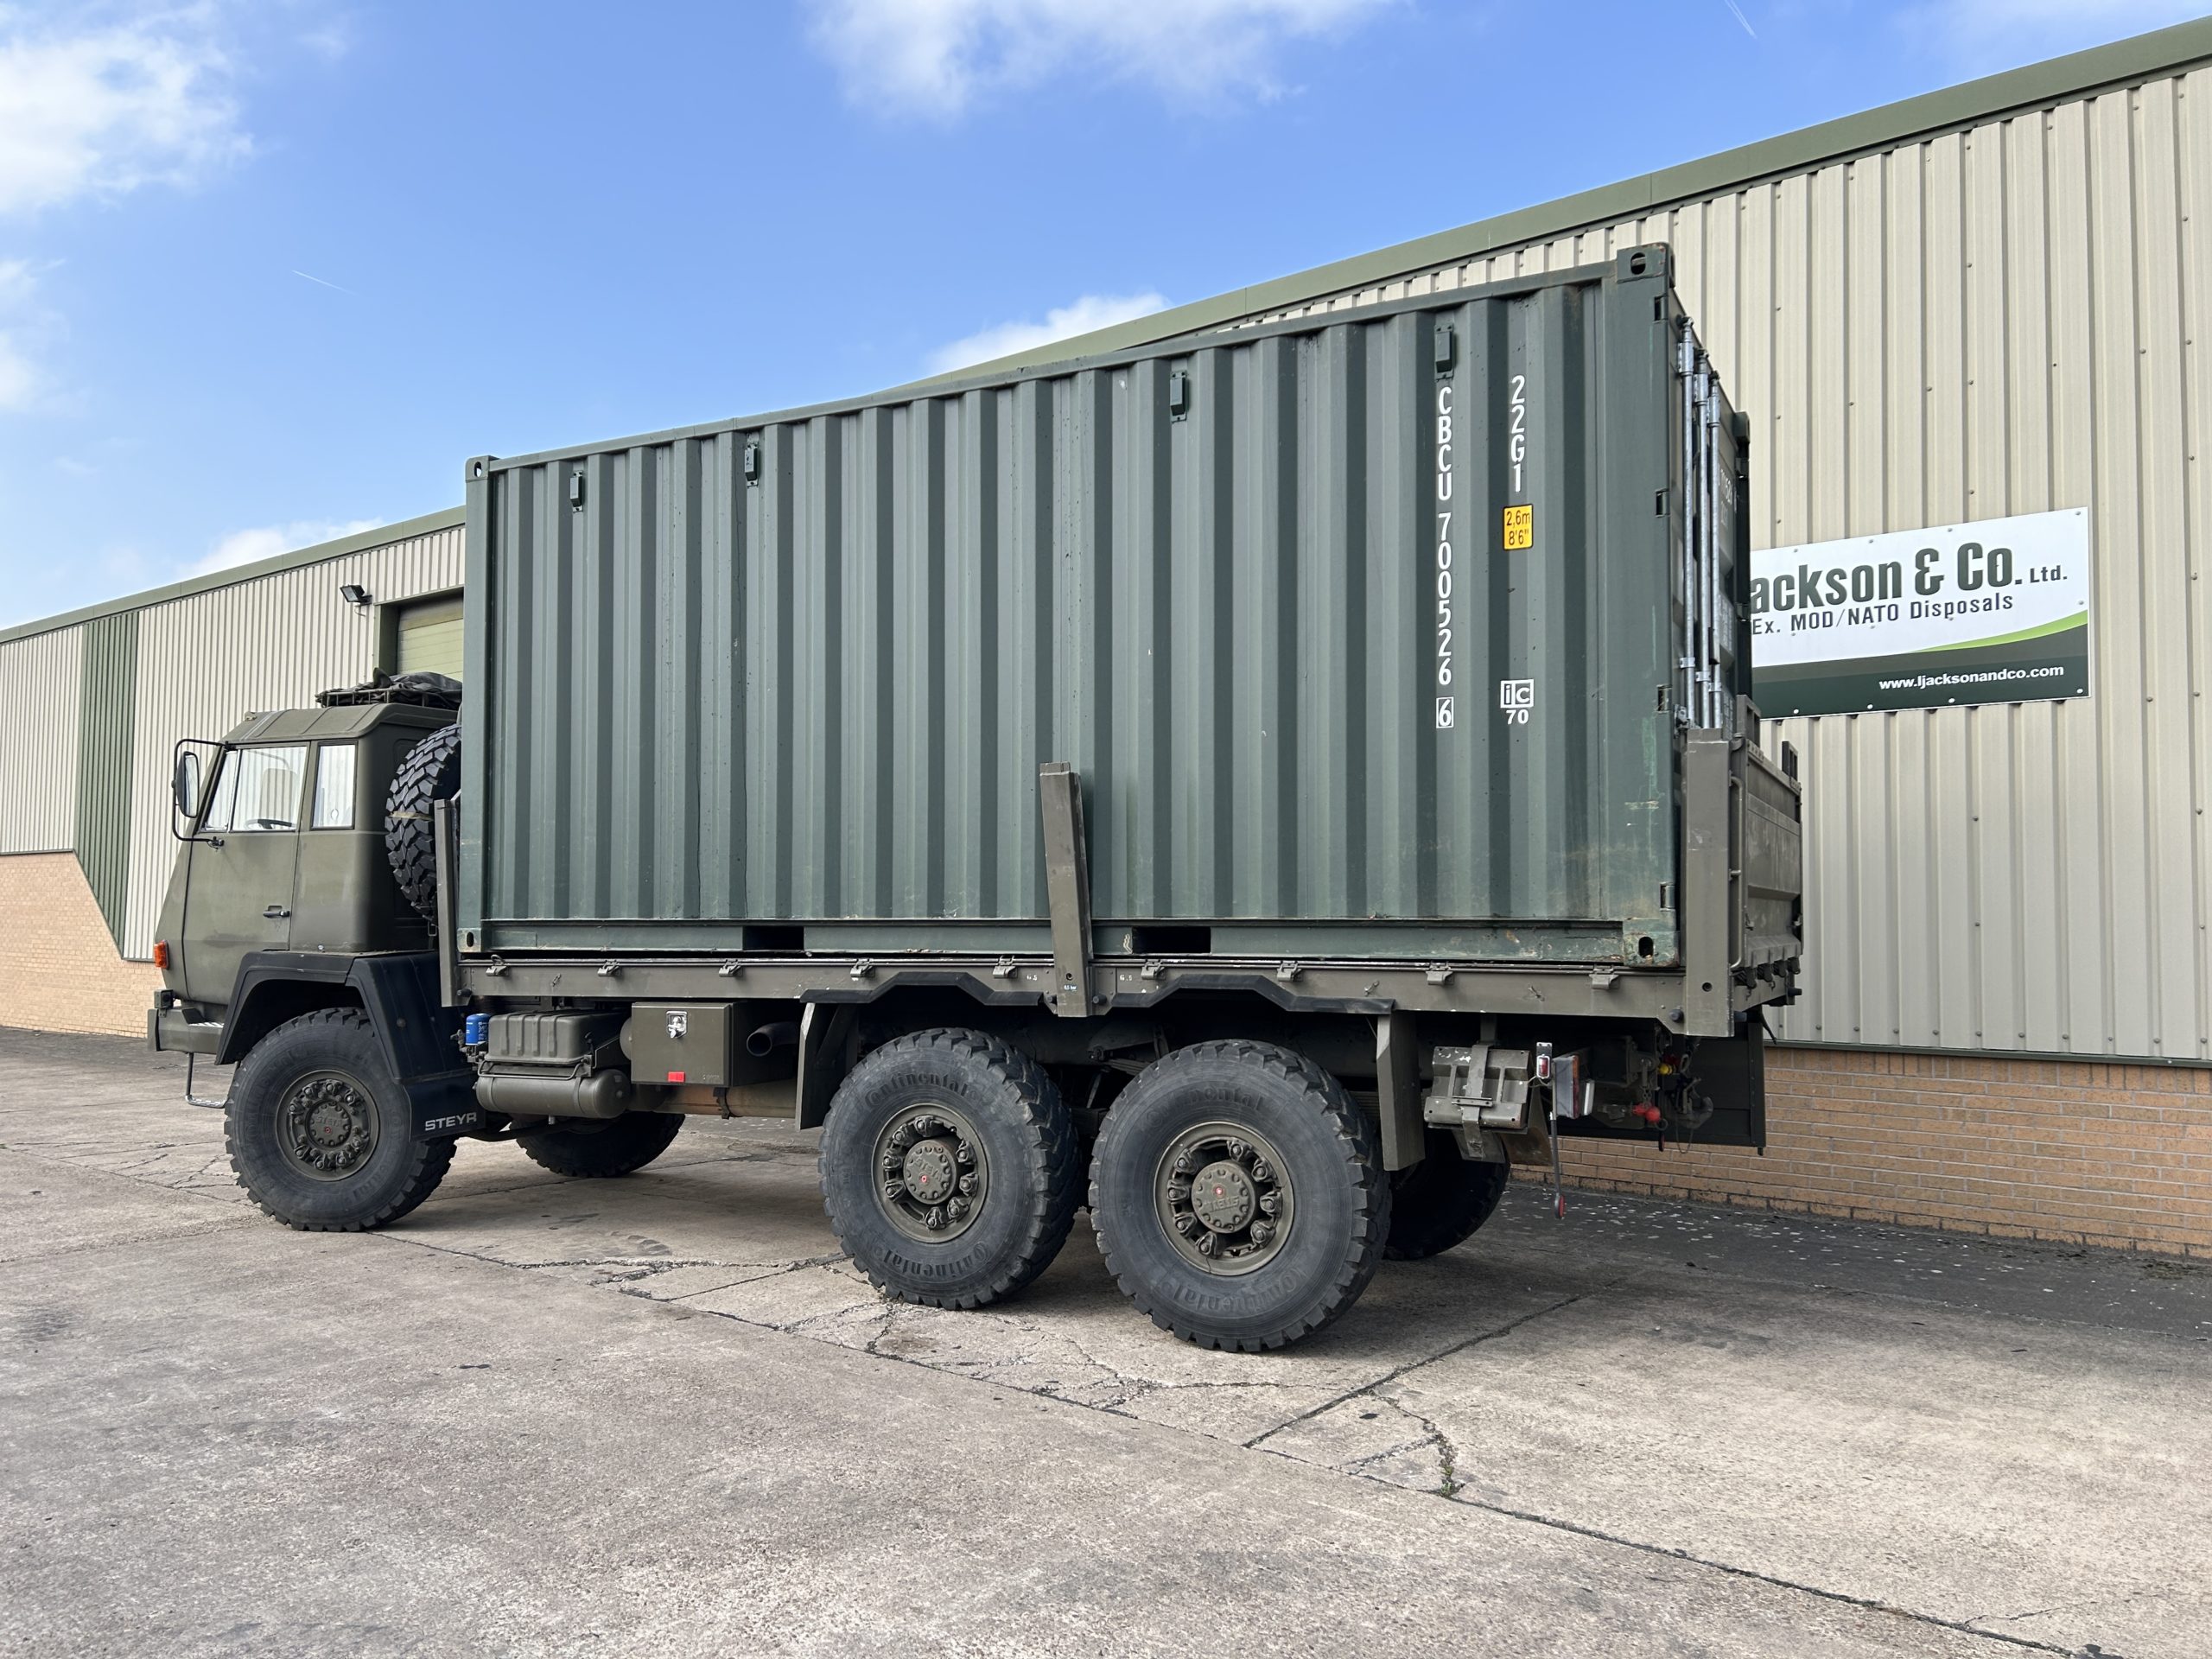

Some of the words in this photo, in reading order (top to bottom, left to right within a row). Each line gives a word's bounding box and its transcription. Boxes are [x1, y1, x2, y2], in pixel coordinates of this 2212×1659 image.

[1438, 386, 1452, 501] CBCU
[1510, 375, 1525, 493] 22G1
[1438, 512, 1452, 685] 700526
[1751, 560, 1902, 614] ackson
[1914, 548, 1944, 595] &
[1957, 542, 2023, 591] Co.
[2030, 564, 2069, 583] Ltd.
[1752, 618, 1781, 635] Ex.
[1790, 604, 1899, 632] MOD/NATO
[1910, 592, 2014, 620] Disposals
[1878, 664, 2065, 690] www.ljacksonandco.com
[1438, 698, 1452, 727] 6
[1505, 709, 1529, 725] 70
[425, 1111, 477, 1131] STEYR
